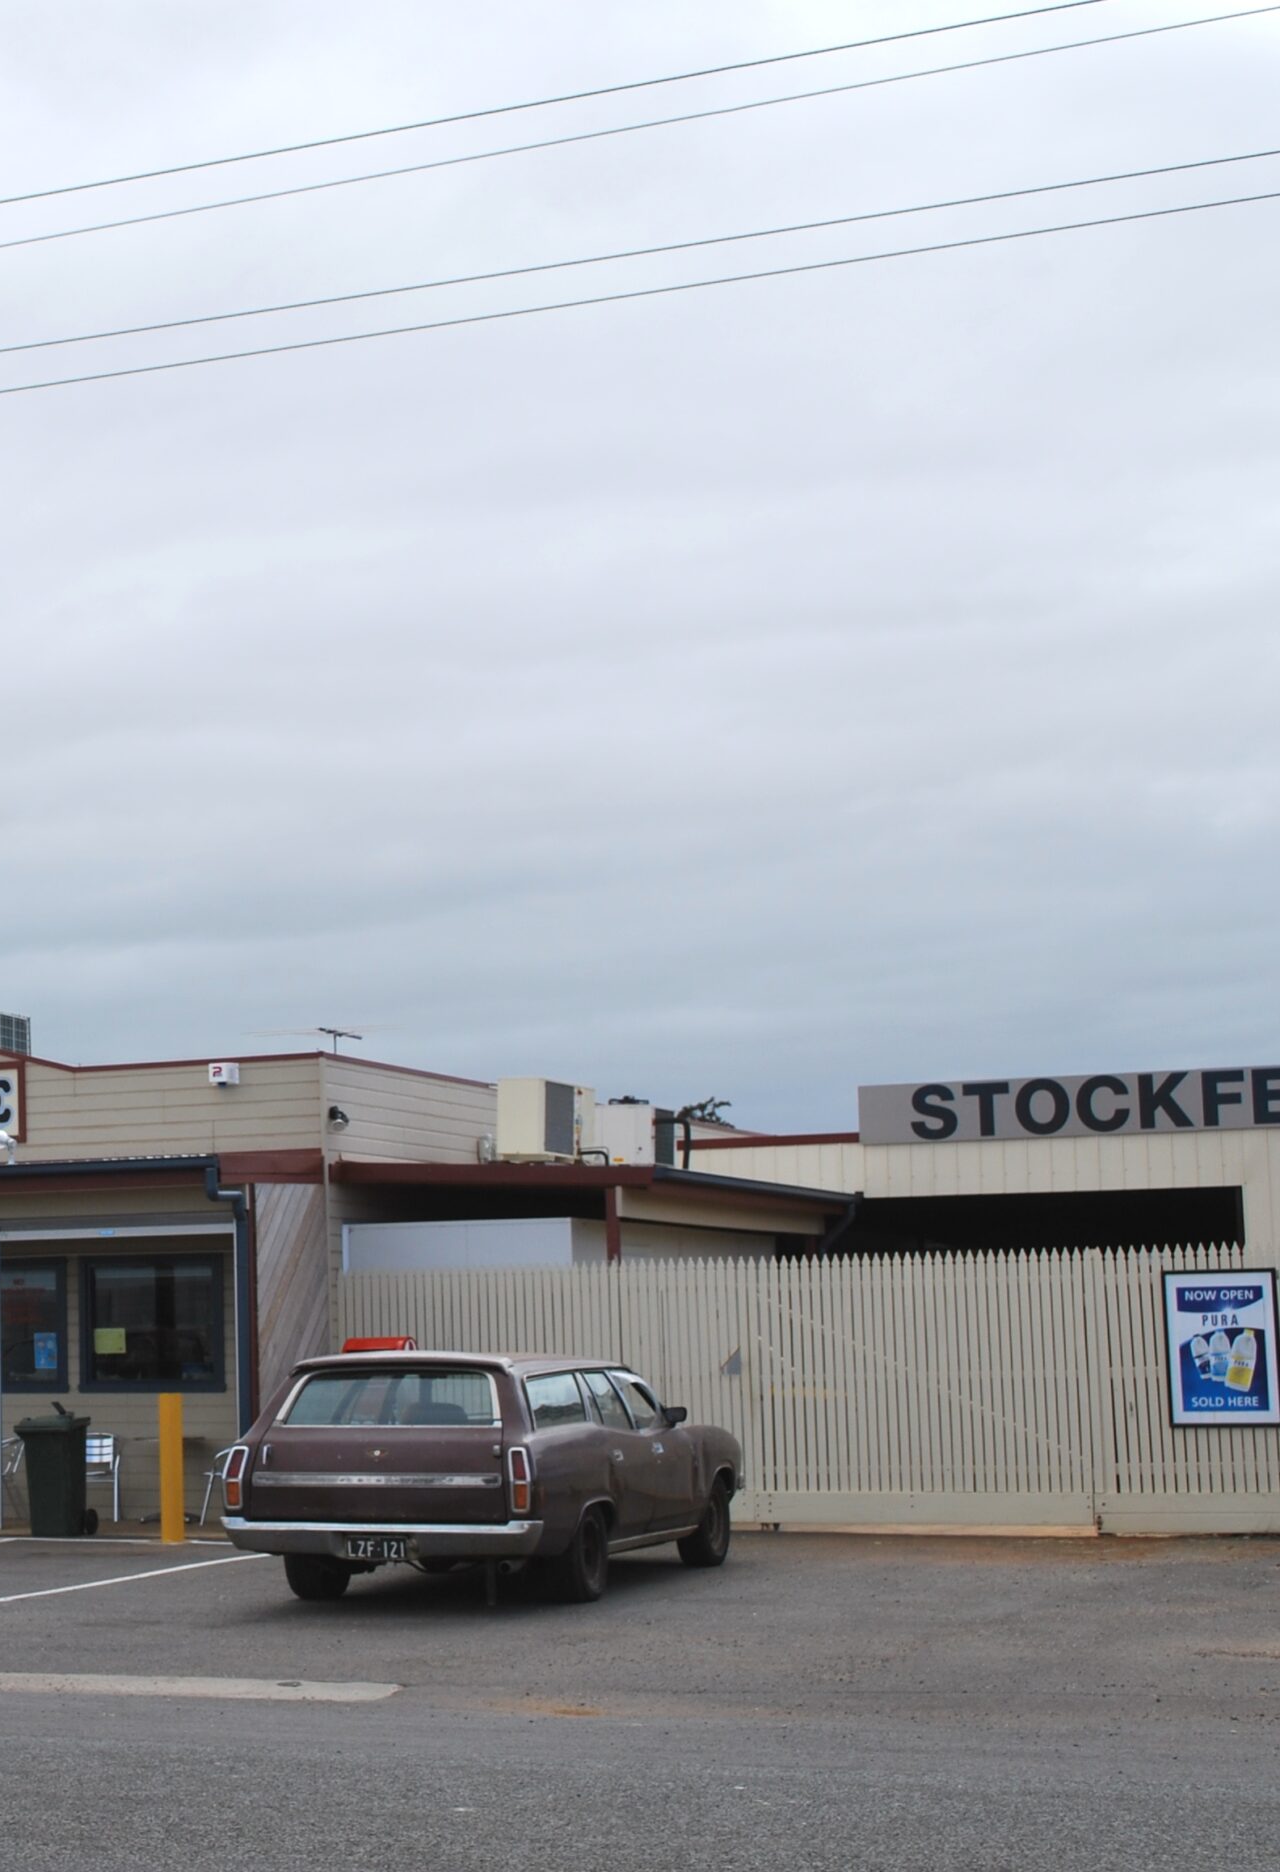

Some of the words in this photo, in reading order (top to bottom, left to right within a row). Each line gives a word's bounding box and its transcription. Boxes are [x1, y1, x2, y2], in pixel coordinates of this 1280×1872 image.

[910, 1068, 1280, 1140] STOCKFE
[1184, 1290, 1217, 1301] NOW
[1220, 1289, 1254, 1300] OPEN
[1201, 1314, 1239, 1326] PURA
[1191, 1396, 1224, 1407] SOLD
[1228, 1395, 1259, 1407] HERE
